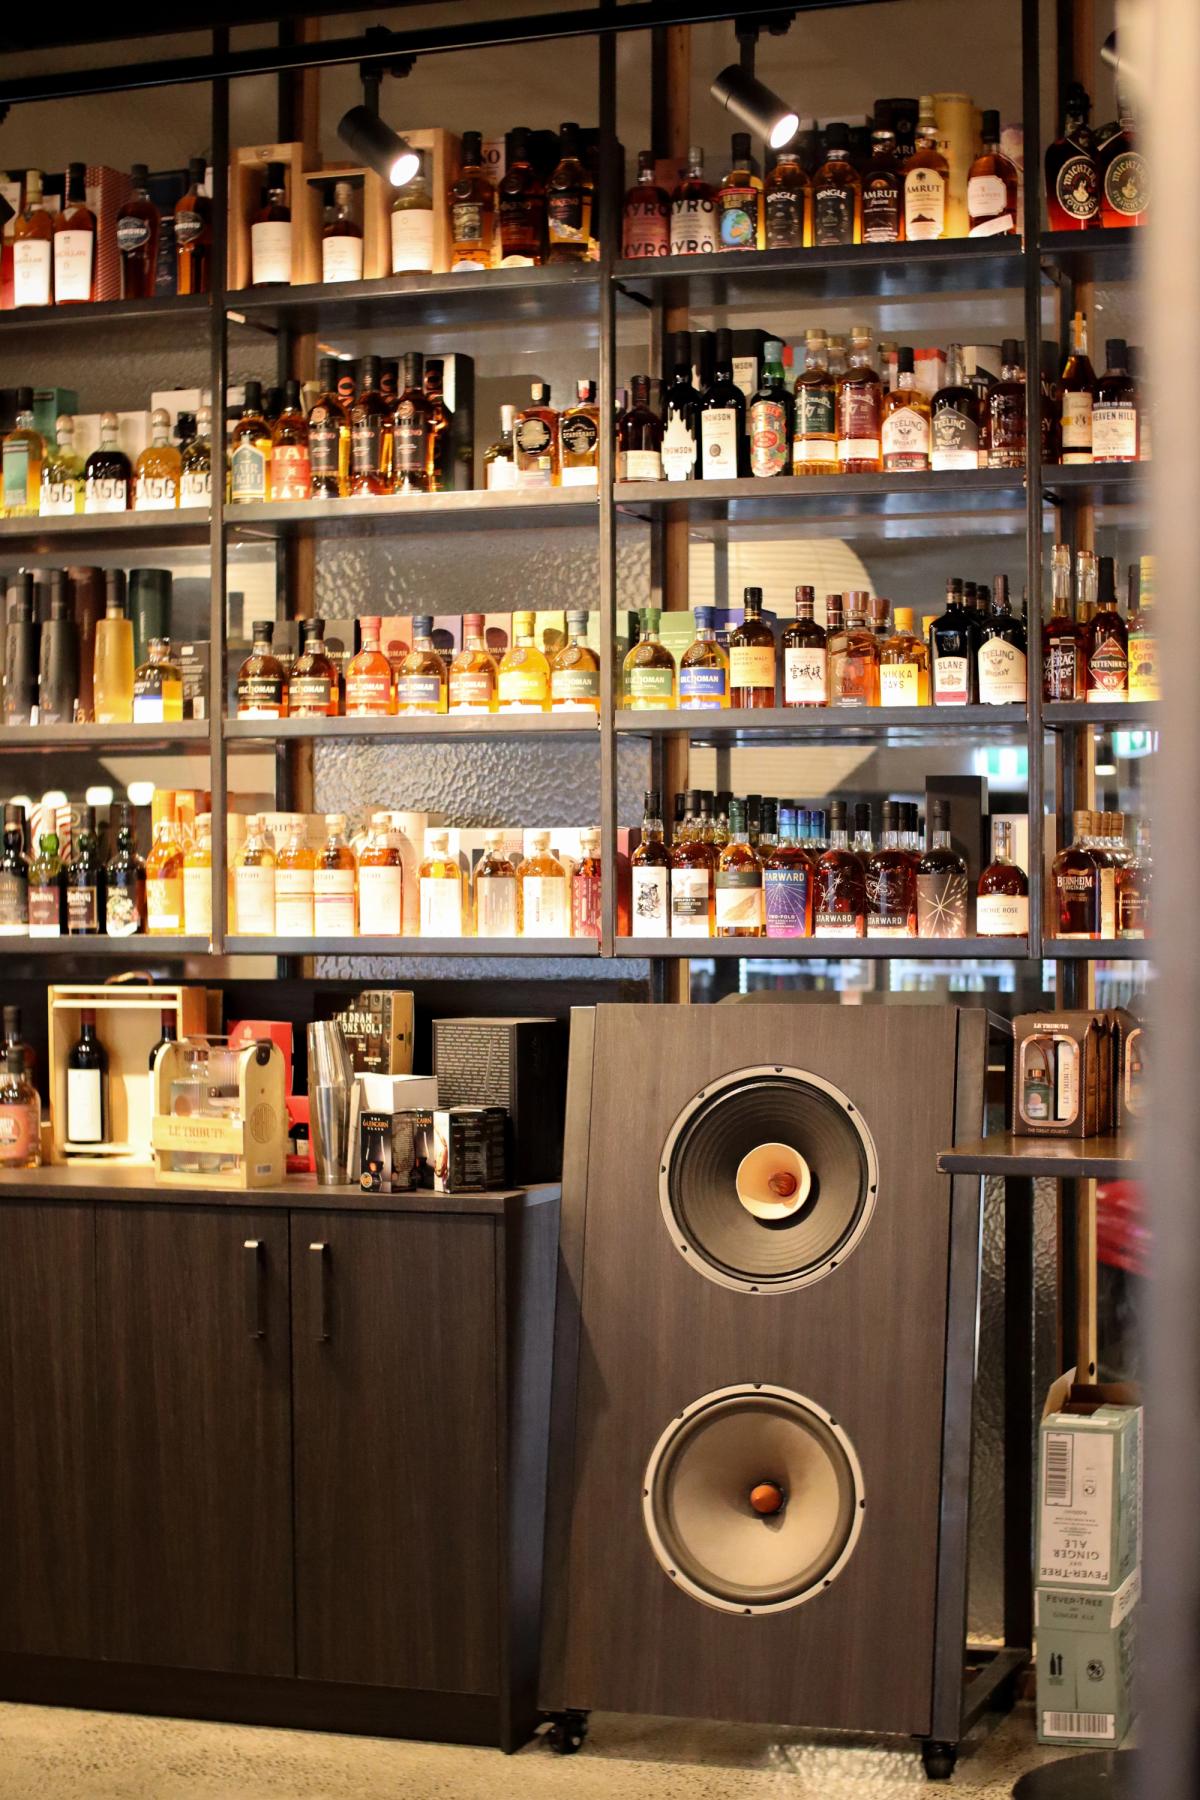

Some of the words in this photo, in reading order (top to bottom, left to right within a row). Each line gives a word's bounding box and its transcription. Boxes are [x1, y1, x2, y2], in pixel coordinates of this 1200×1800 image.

[816, 188, 848, 201] DINGLE
[863, 190, 899, 200] AMRUT
[906, 184, 942, 194] AMRUT
[767, 191, 798, 203] DINGLE
[1118, 411, 1134, 422] HILL
[889, 420, 922, 432] TEELING
[934, 417, 966, 431] TEELING
[938, 660, 964, 671] SLANE
[883, 670, 913, 679] NIKKA
[1057, 876, 1093, 888] BERNHEIM
[1002, 906, 1019, 914] ROSE
[816, 914, 852, 923] STARWARD
[867, 916, 902, 925] STARWARD
[349, 1012, 373, 1024] DRAM
[360, 1023, 384, 1035] VOL.1
[1064, 1539, 1087, 1549] ALE
[1053, 1549, 1100, 1561] GINGER
[1041, 1567, 1108, 1581] FEVER-TREE
[1046, 1594, 1103, 1607] FEVER-TREE
